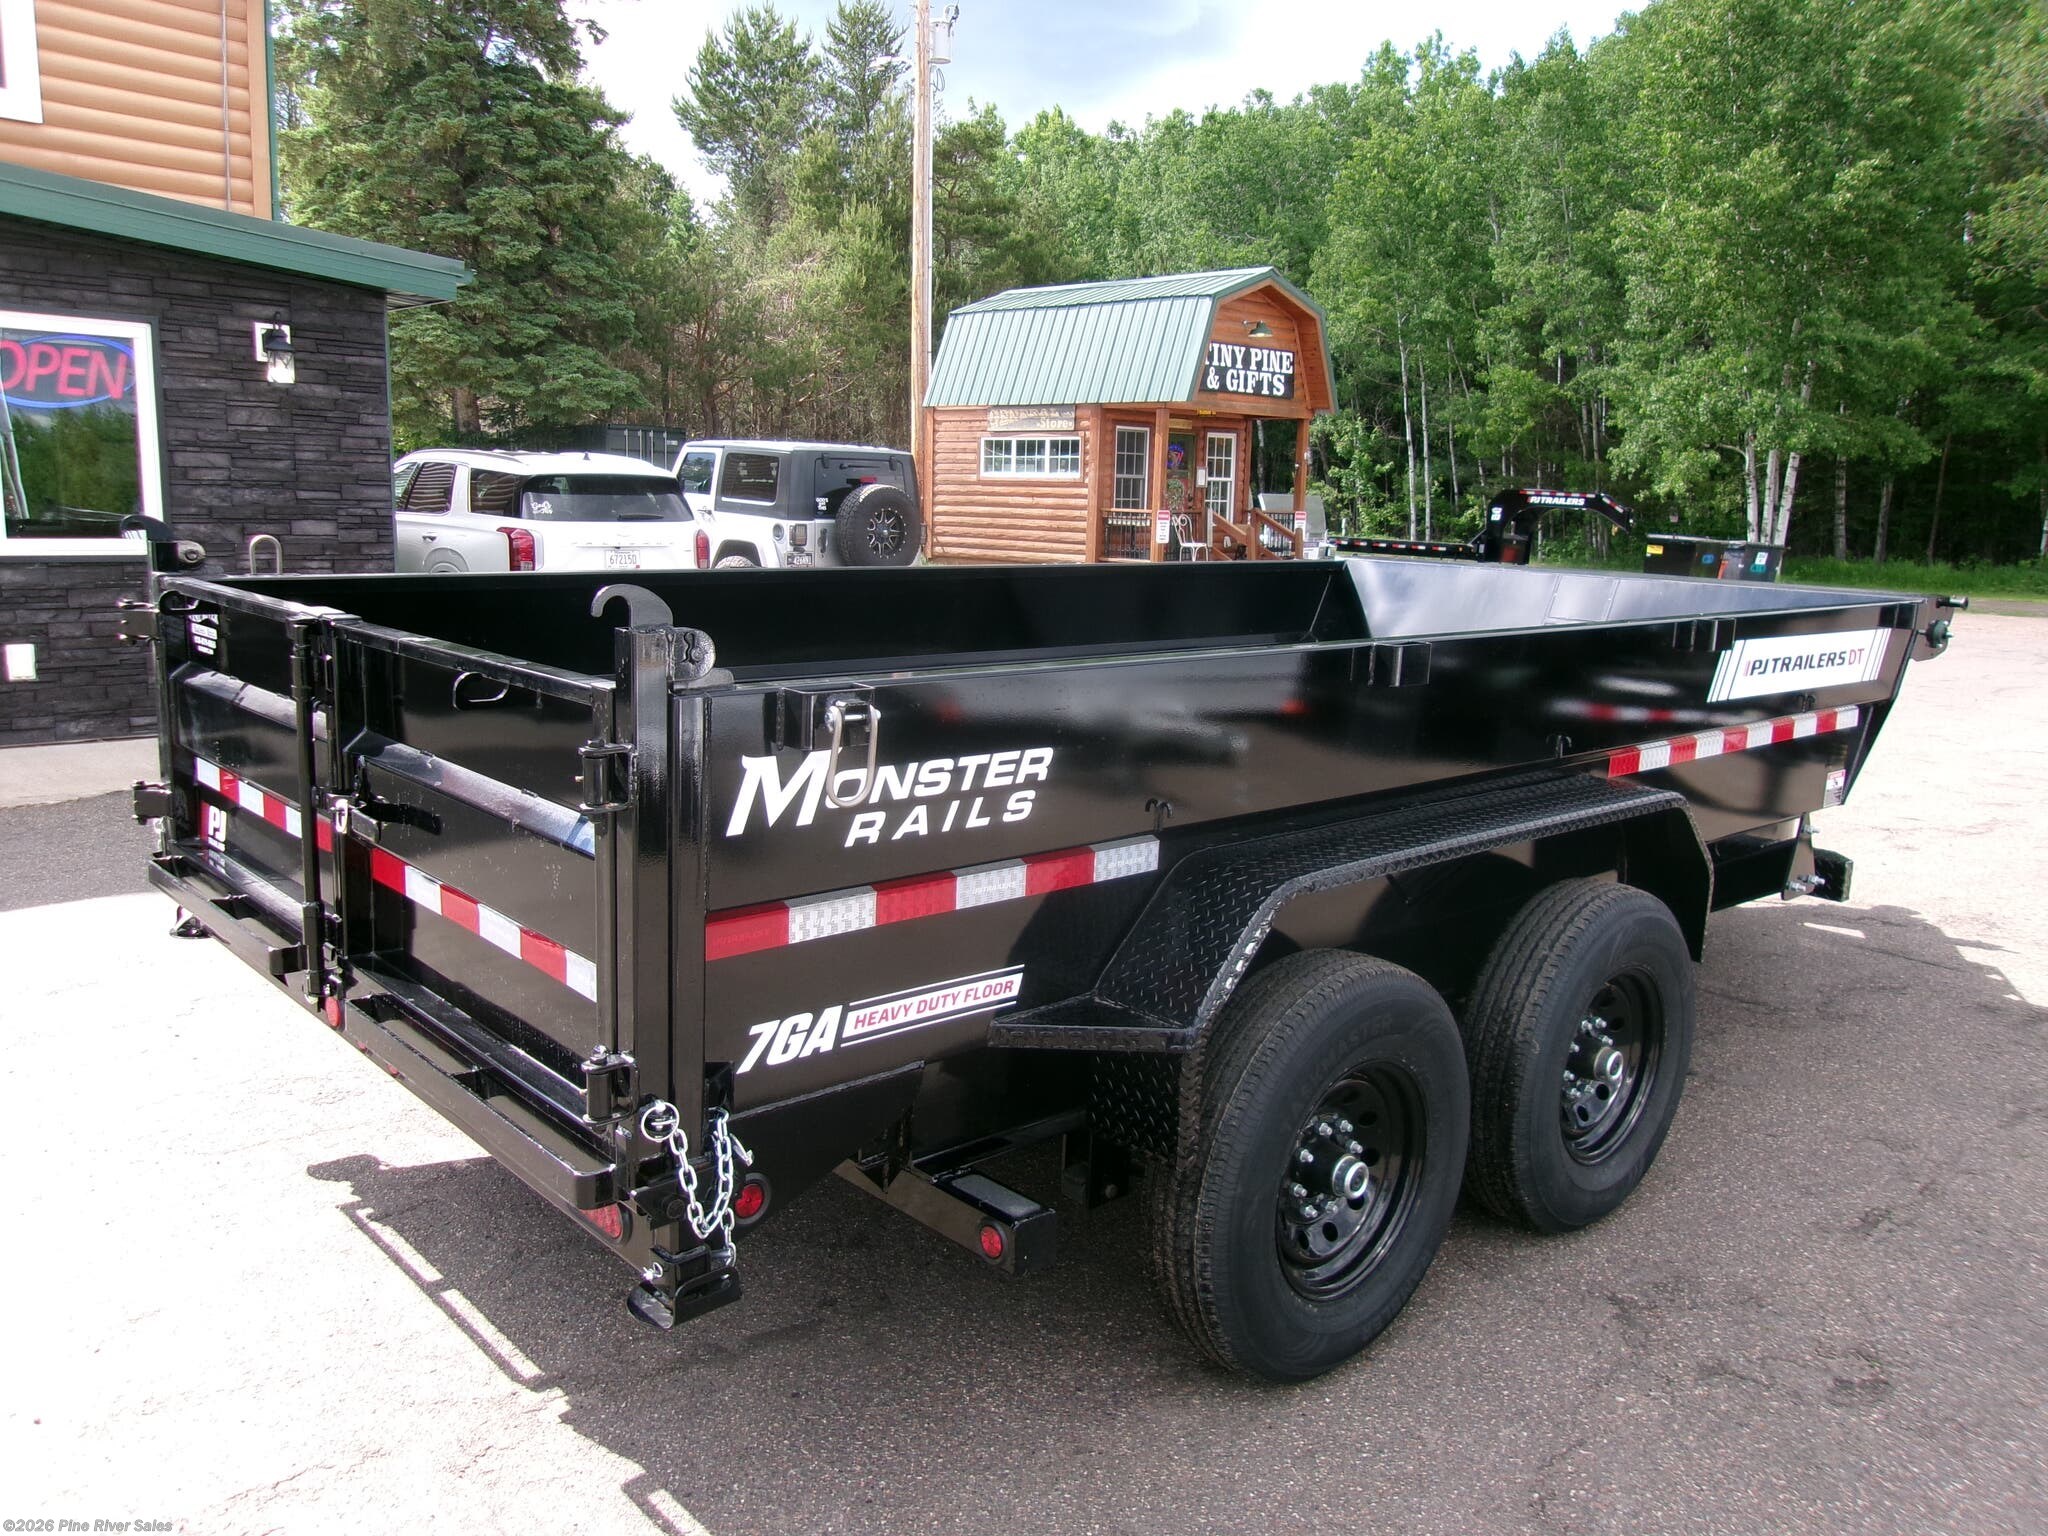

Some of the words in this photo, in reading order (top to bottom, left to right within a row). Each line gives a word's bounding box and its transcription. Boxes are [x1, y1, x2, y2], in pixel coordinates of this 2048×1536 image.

[0, 340, 128, 399] OPEN
[1250, 347, 1293, 374] PINE
[1206, 367, 1219, 390] &
[1226, 368, 1285, 396] GIFTS
[1540, 496, 1585, 506] TRAILERS
[1750, 659, 1769, 676] PJ
[1771, 651, 1847, 673] TRAILERS
[1848, 648, 1865, 665] DT
[726, 747, 1054, 837] MONSTER
[208, 805, 228, 843] PJ
[844, 789, 1037, 848] RAILS
[736, 1004, 844, 1075] 7GA
[853, 1002, 914, 1030] HEAVY
[916, 991, 961, 1015] DUTY
[963, 980, 1014, 1005] FLOOR
